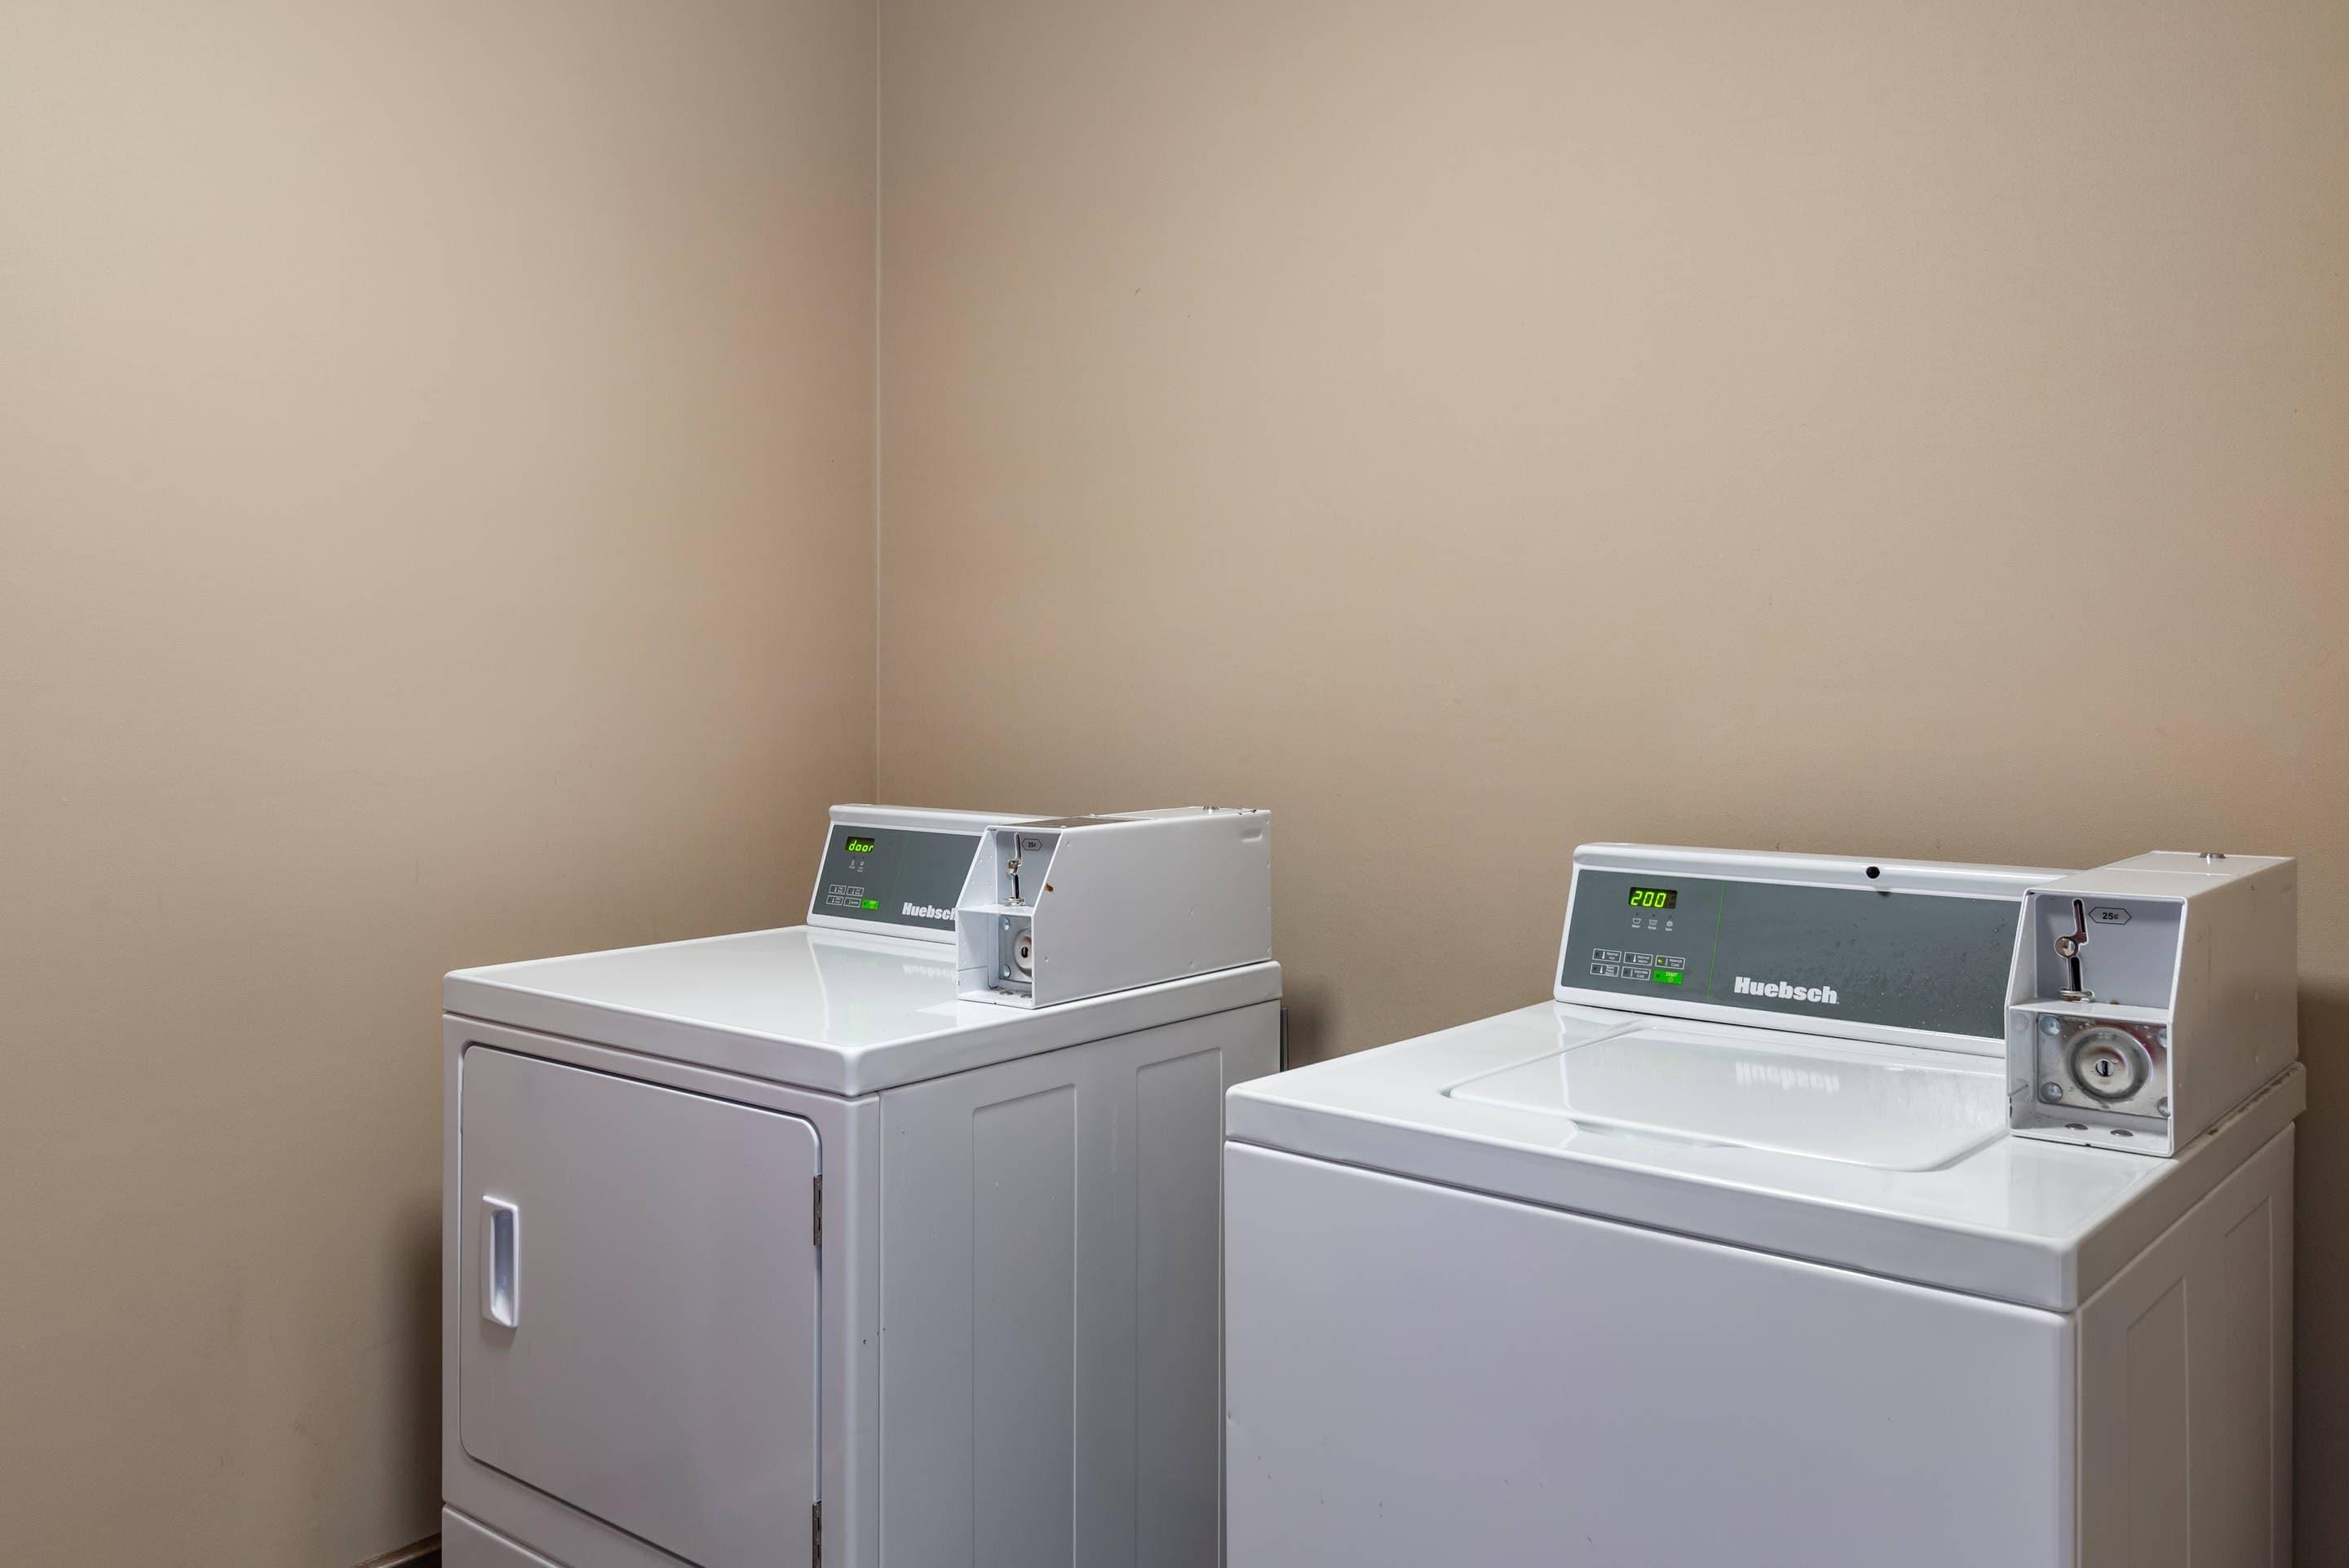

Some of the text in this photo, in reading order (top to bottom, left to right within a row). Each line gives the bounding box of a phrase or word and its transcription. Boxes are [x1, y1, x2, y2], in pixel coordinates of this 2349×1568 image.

[848, 839, 874, 852] door
[1630, 890, 1666, 908] 200
[1734, 976, 1838, 1004] Huebsch
